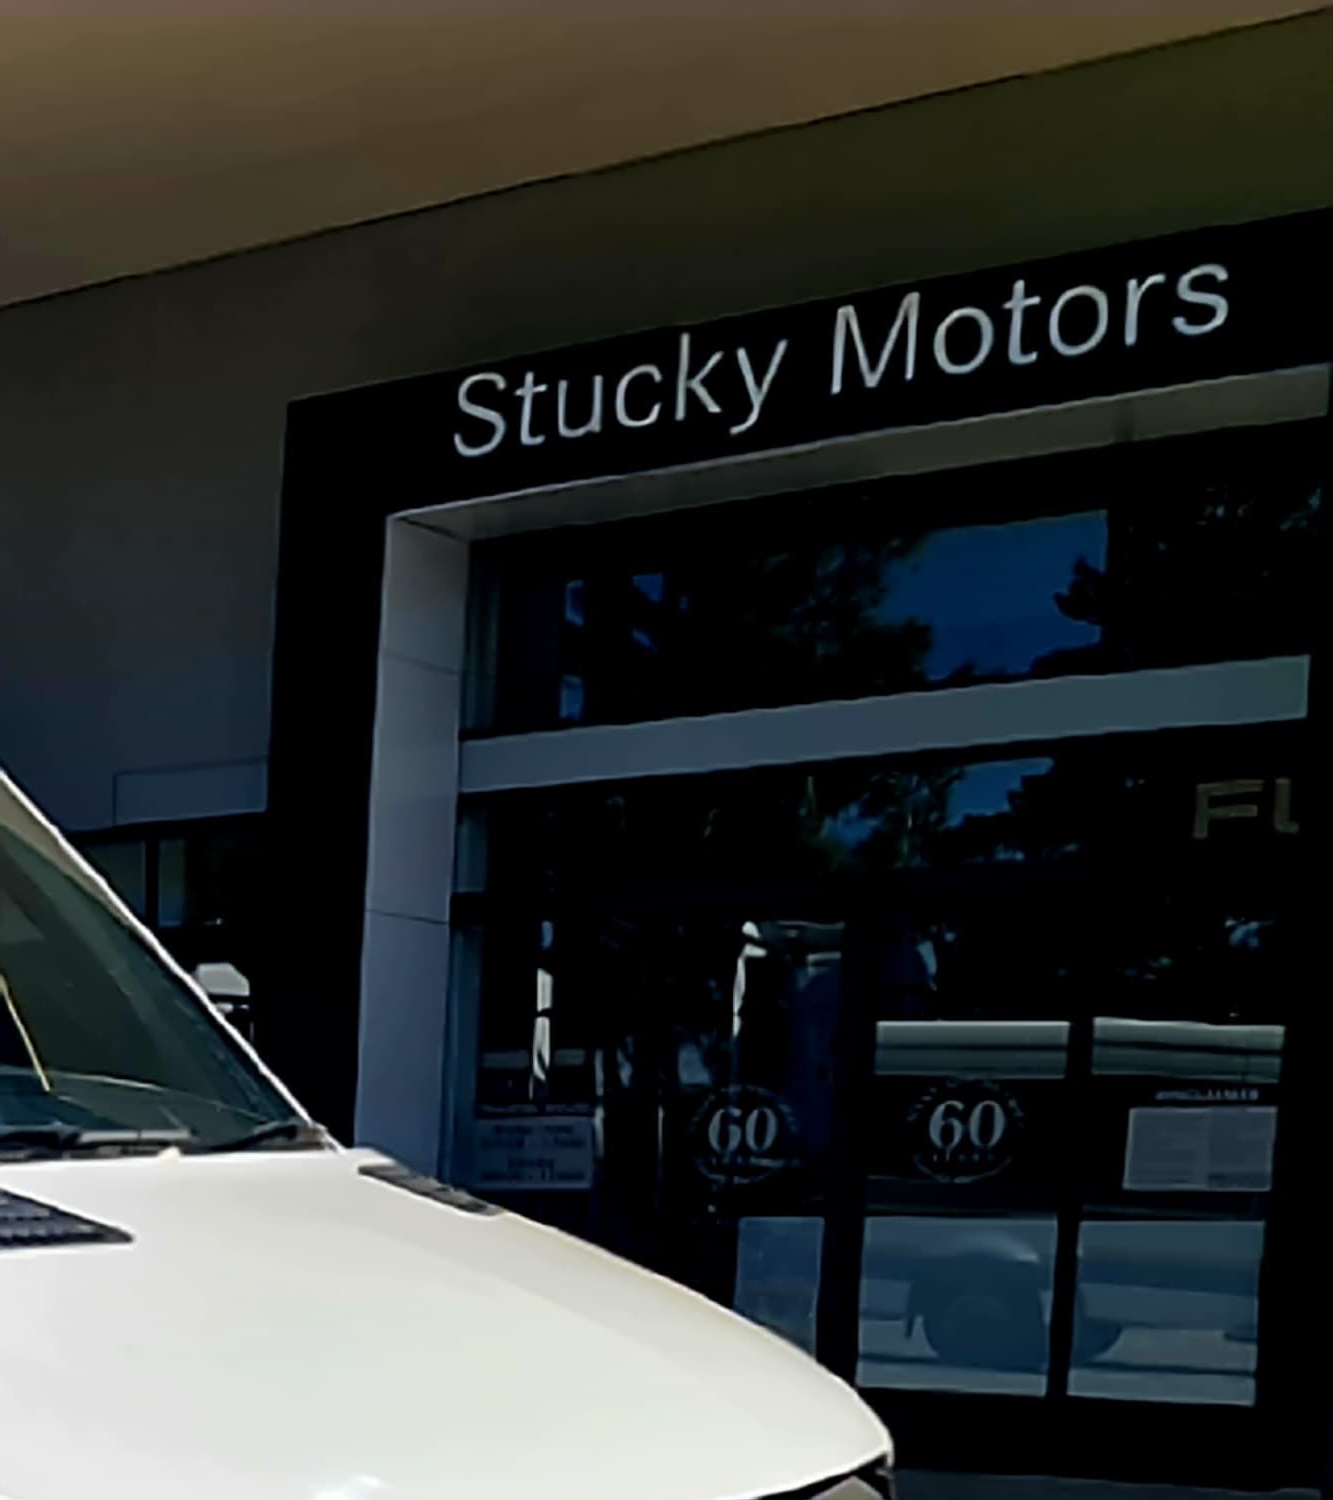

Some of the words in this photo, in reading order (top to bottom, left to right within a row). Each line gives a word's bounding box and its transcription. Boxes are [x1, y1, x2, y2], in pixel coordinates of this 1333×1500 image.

[452, 331, 789, 458] Stucky
[829, 262, 1230, 396] Motors
[707, 1106, 780, 1155] 60
[928, 1099, 1007, 1152] 60
